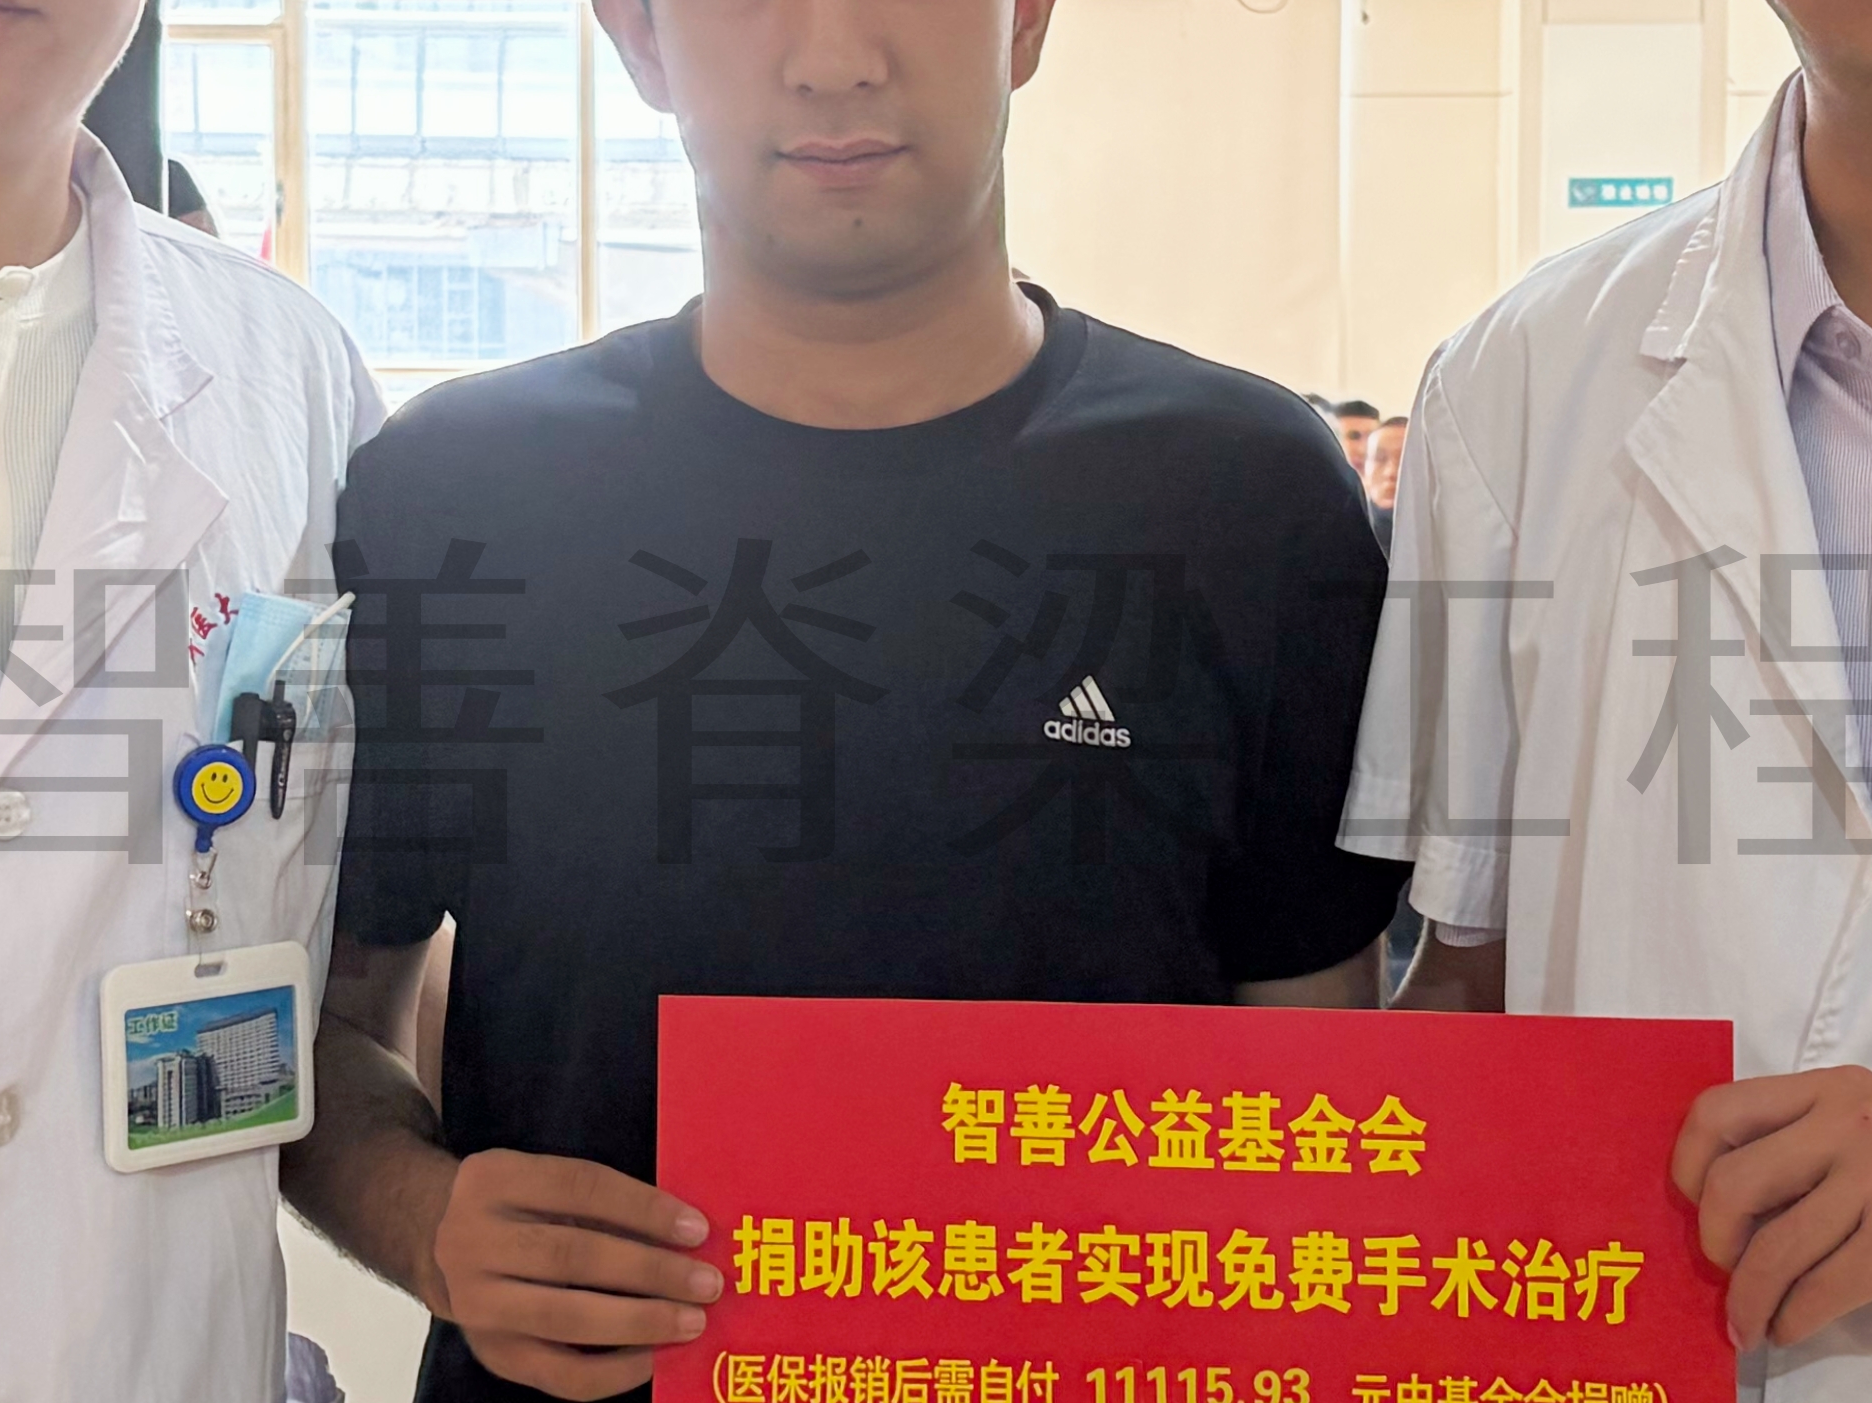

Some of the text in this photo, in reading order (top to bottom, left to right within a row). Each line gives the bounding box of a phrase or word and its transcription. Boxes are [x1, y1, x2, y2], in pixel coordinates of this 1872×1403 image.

[1043, 719, 1131, 748] adidas
[942, 1083, 1428, 1177] 智善公益基金会
[732, 1216, 1646, 1326] 捐助该患者实现免费手术治疗
